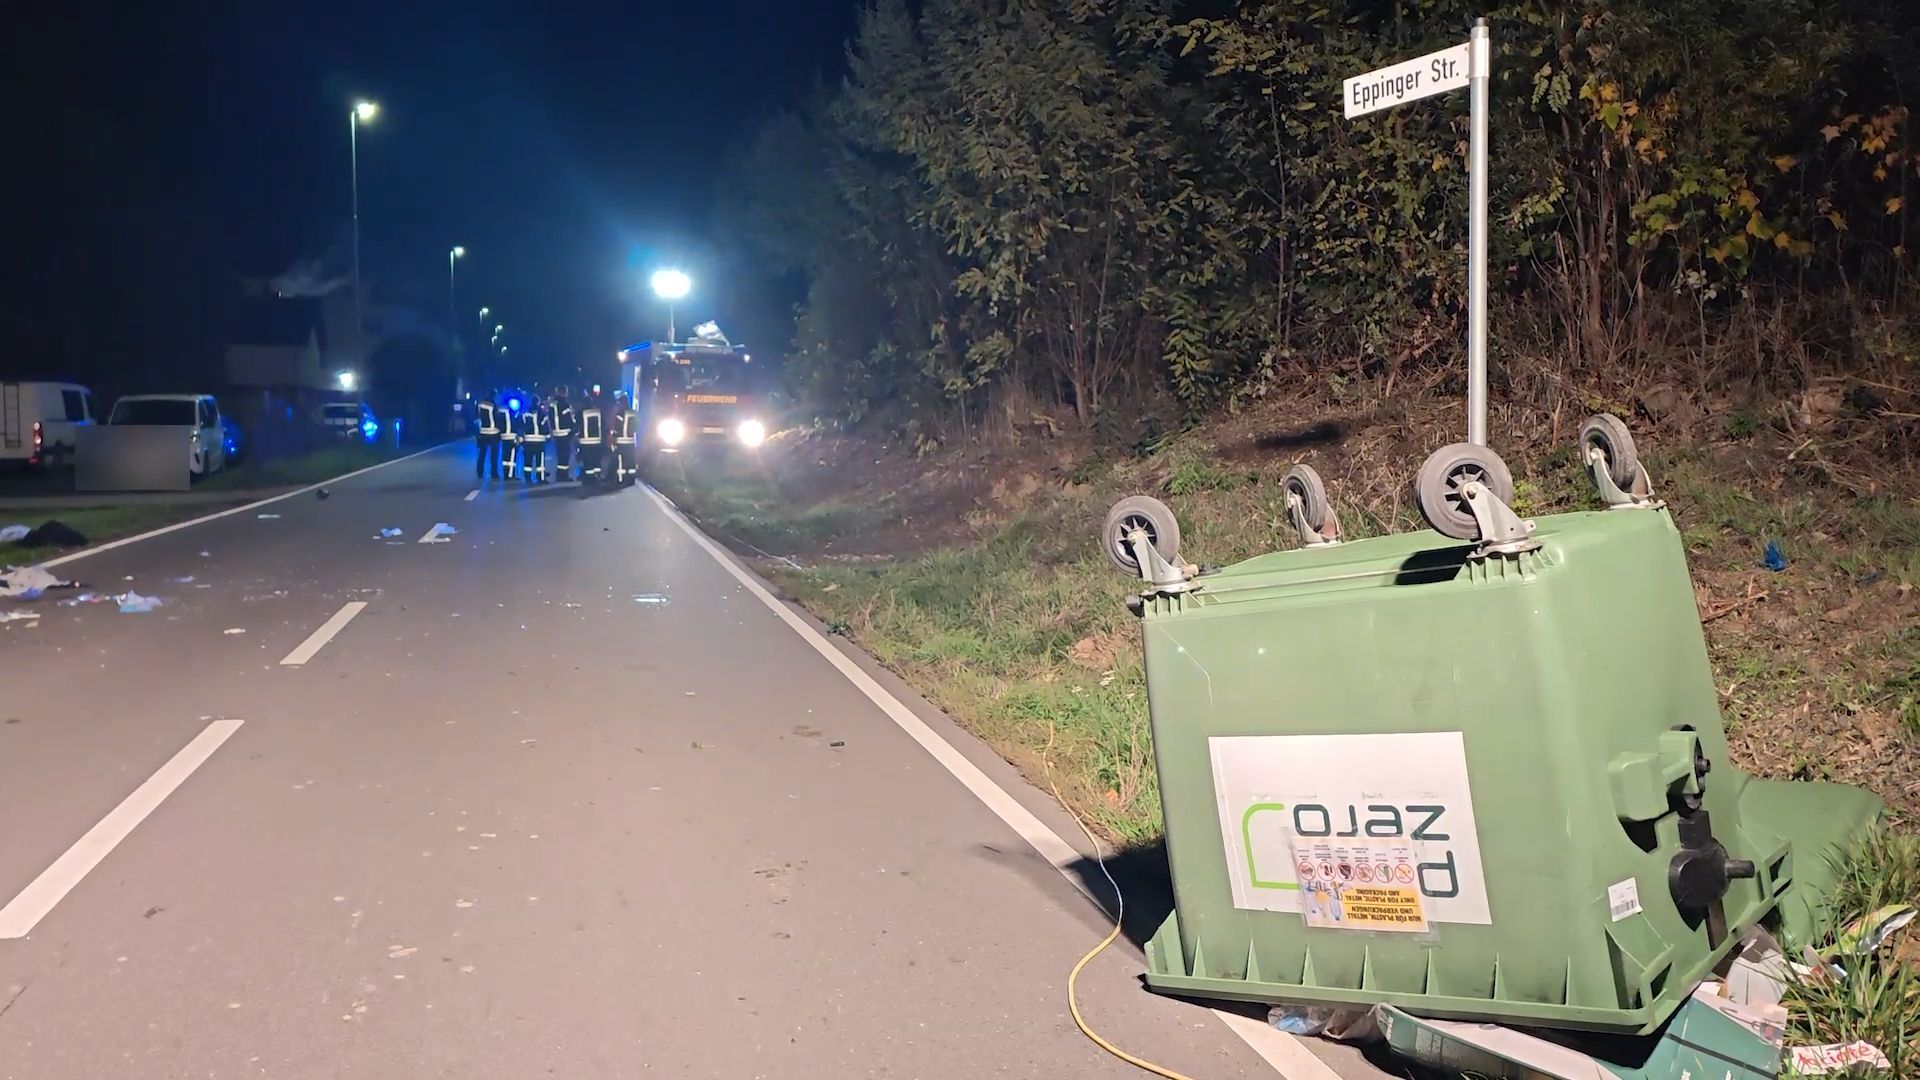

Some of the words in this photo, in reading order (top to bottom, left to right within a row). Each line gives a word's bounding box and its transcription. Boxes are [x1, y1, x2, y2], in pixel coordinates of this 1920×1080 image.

[1353, 70, 1422, 109] Eppinger
[1431, 57, 1459, 83] Str.
[687, 395, 737, 404] FEUERWEHR
[1395, 915, 1407, 923] FÜR
